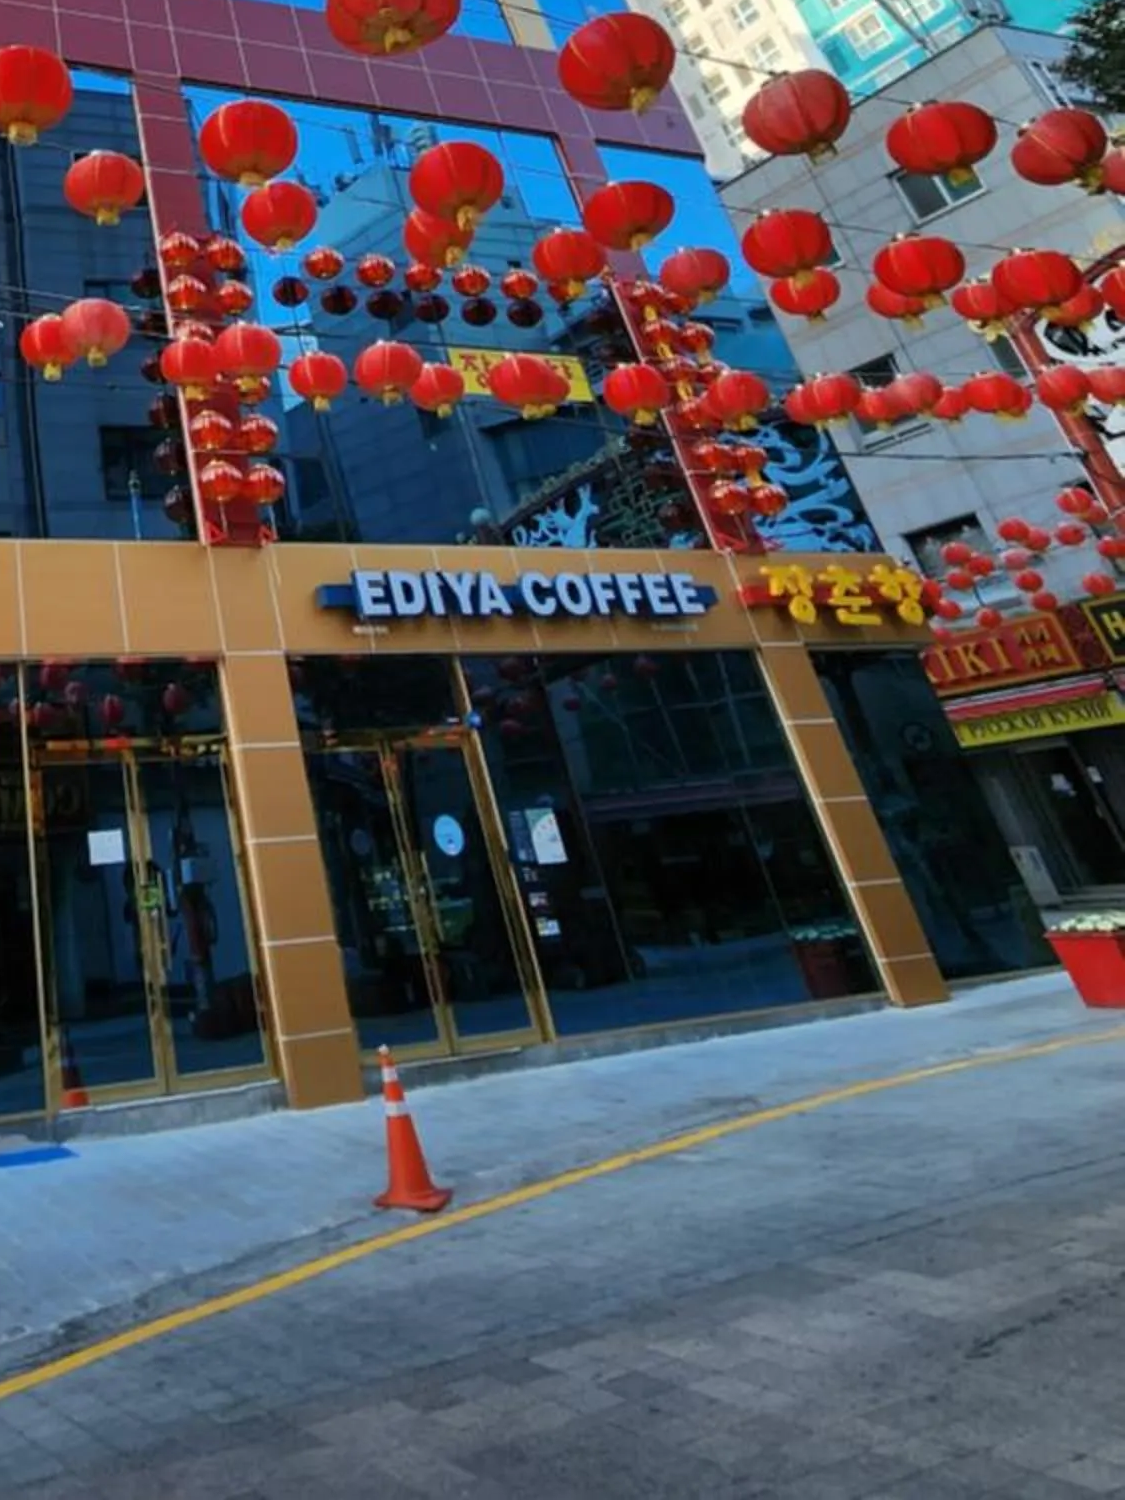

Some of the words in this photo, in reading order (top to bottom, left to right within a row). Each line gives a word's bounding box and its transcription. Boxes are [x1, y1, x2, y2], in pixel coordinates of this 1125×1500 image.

[352, 570, 514, 617] EDIYA
[520, 570, 707, 617] COFFEE
[924, 636, 1013, 684] IKI
